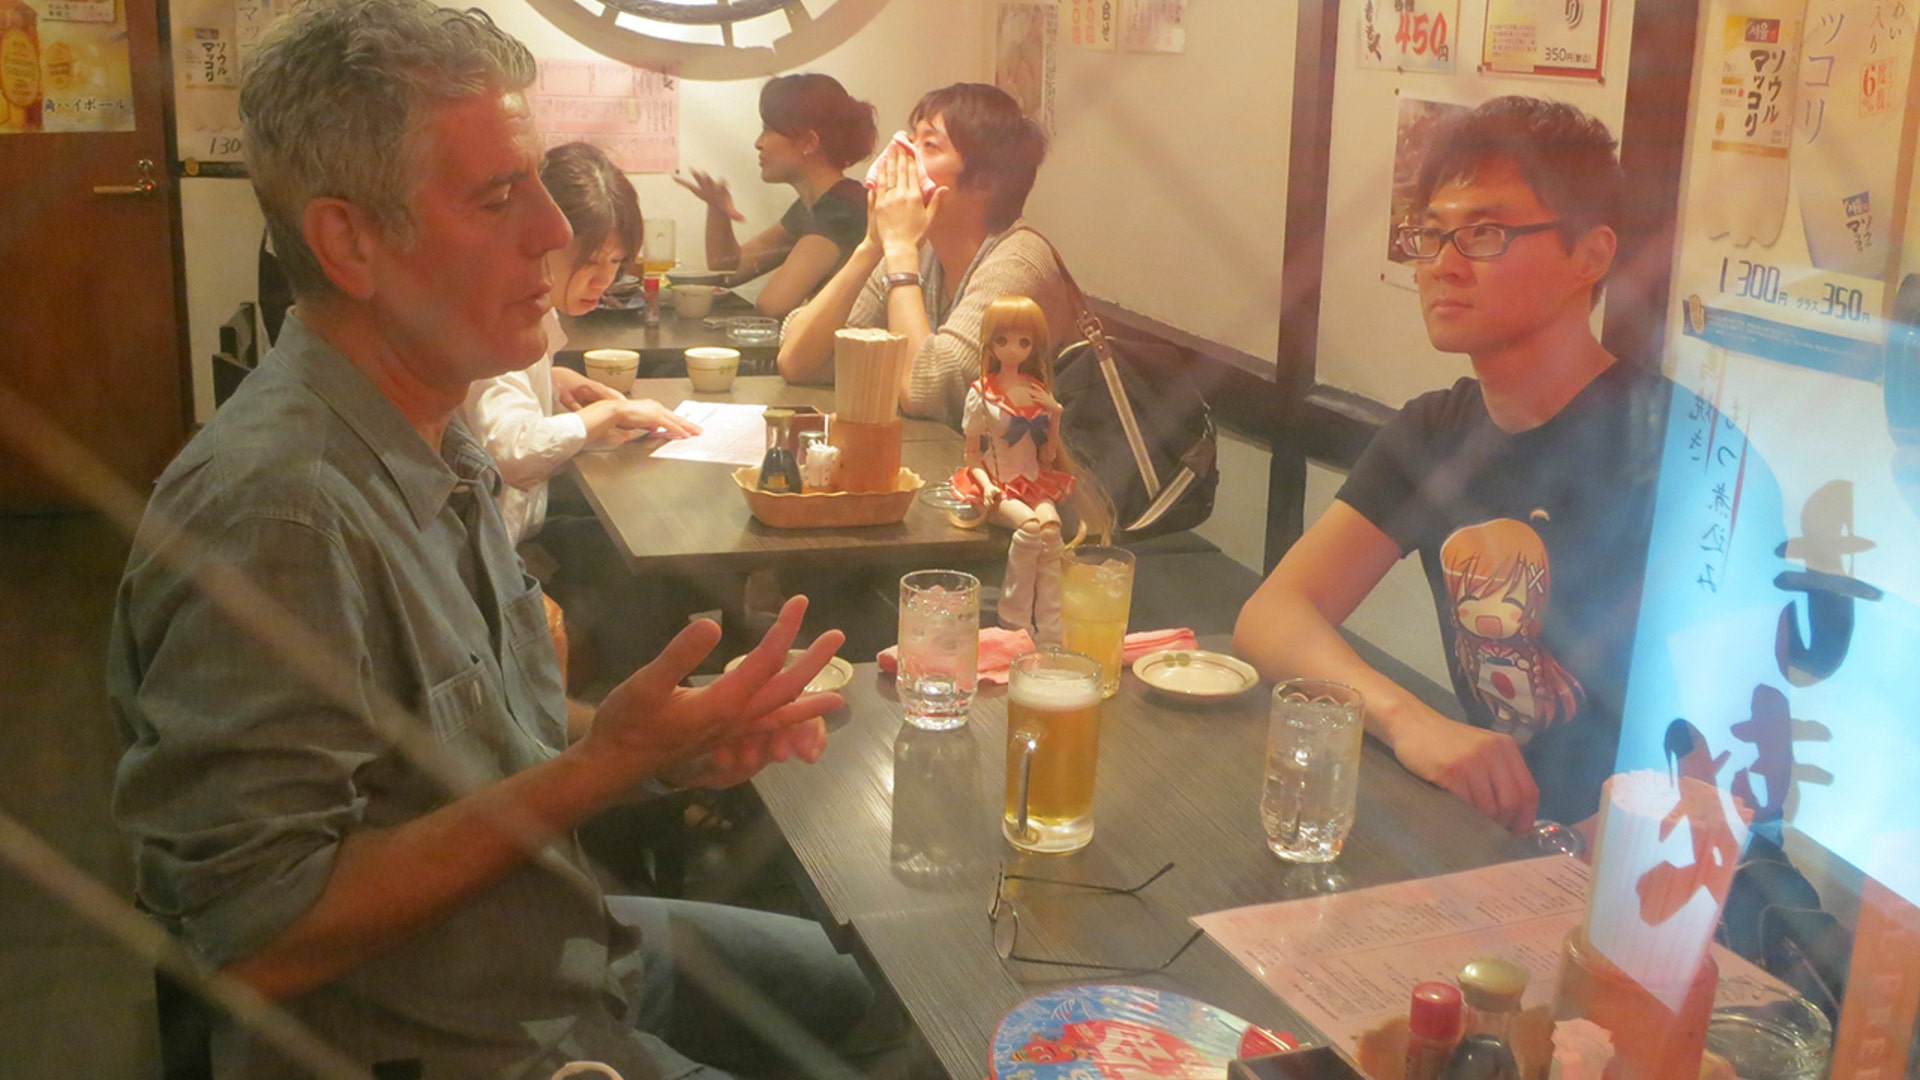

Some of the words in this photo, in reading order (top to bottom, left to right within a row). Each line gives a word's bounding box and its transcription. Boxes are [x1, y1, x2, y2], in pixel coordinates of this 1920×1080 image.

[1395, 12, 1448, 62] 450円
[1744, 49, 1770, 137] マッコリ
[1763, 50, 1785, 124] ソウル
[209, 137, 242, 155] 130
[1719, 256, 1789, 307] 1300円
[1796, 296, 1820, 312] グラス
[1820, 282, 1871, 324] 350円
